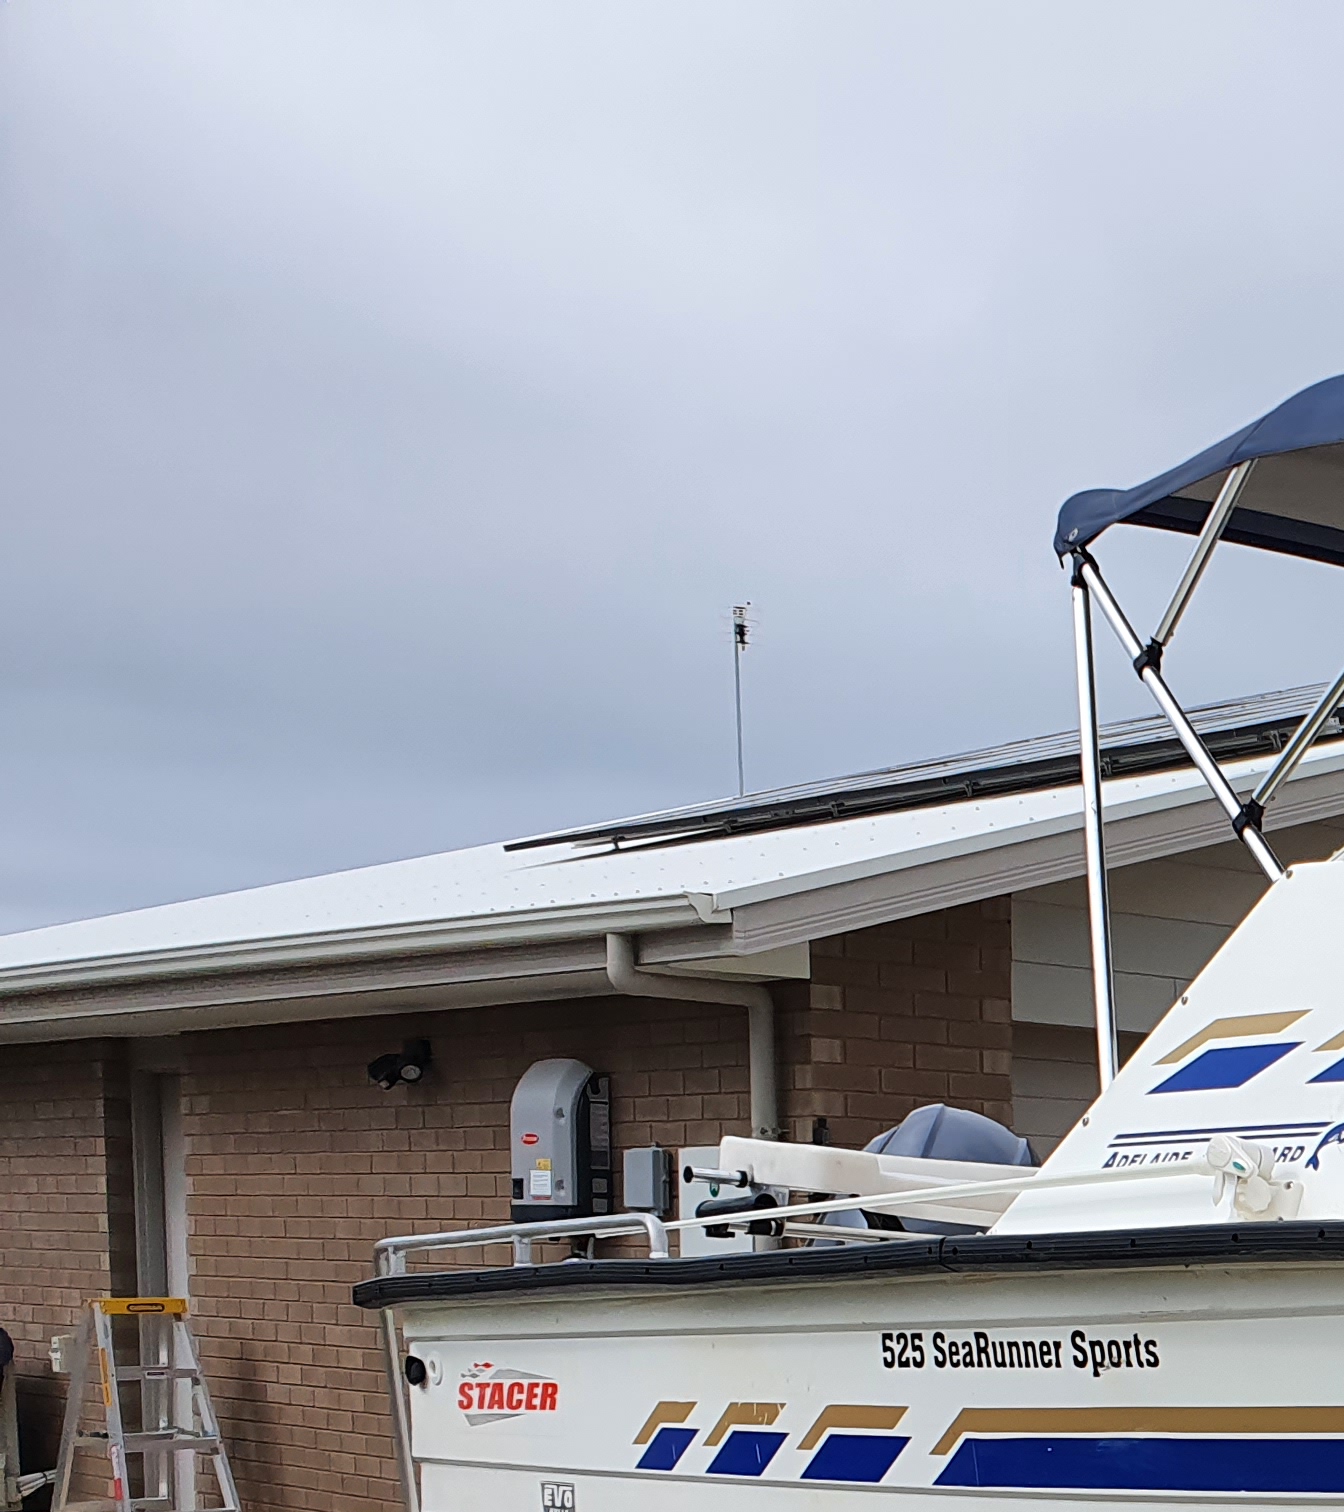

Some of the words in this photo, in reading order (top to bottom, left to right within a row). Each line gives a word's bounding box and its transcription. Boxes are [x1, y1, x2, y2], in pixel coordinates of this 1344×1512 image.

[881, 1332, 926, 1369] 525
[932, 1331, 1062, 1369] SeaRunner
[1070, 1329, 1160, 1378] Sports
[457, 1381, 559, 1411] STACER
[543, 1484, 573, 1508] EVO
